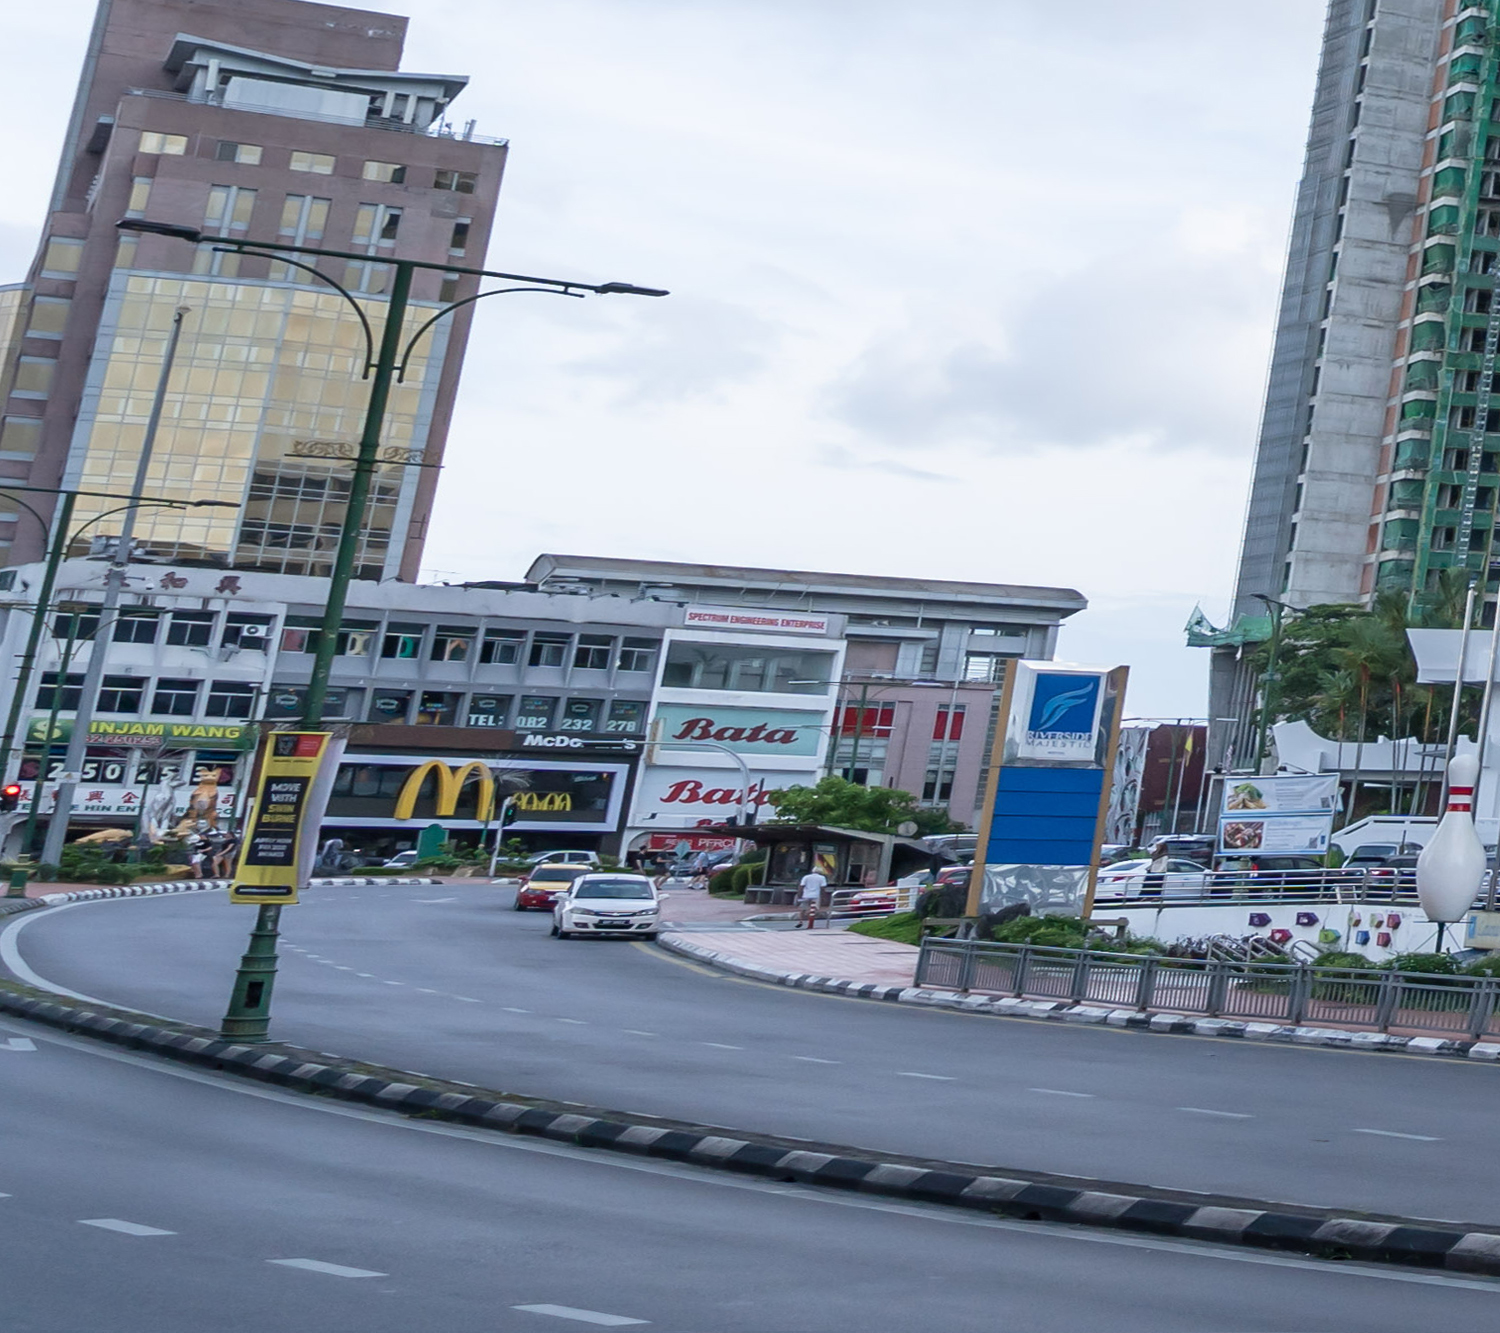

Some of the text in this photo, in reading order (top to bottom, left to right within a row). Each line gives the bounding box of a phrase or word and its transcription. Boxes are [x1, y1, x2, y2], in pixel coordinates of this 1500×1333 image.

[688, 612, 826, 630] SPECTRUM ENGINEERING ENTERPRISE
[90, 721, 164, 736] INJAM
[172, 724, 241, 738] WANG
[469, 714, 637, 732] TEL: 082 232 278
[672, 718, 799, 744] Bata
[523, 734, 637, 750] McDo's
[1027, 731, 1093, 741] RIVERSIDE
